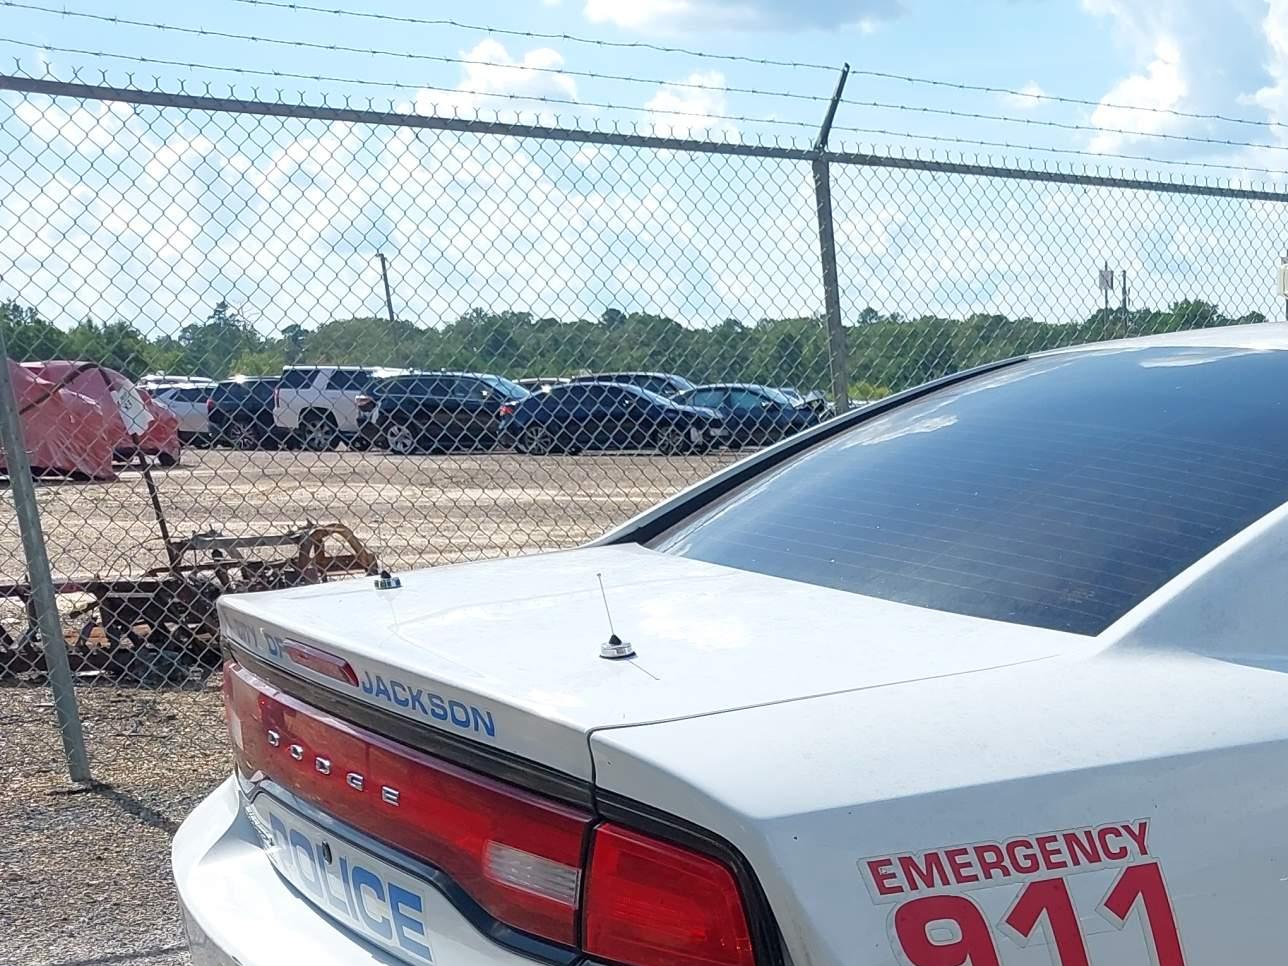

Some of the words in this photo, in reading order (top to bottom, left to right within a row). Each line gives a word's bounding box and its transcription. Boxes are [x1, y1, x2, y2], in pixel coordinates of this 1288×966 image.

[362, 671, 495, 737] JACKSON
[267, 730, 400, 806] DODGE
[269, 812, 433, 963] POLICE
[867, 820, 1150, 896] EMERGENCY
